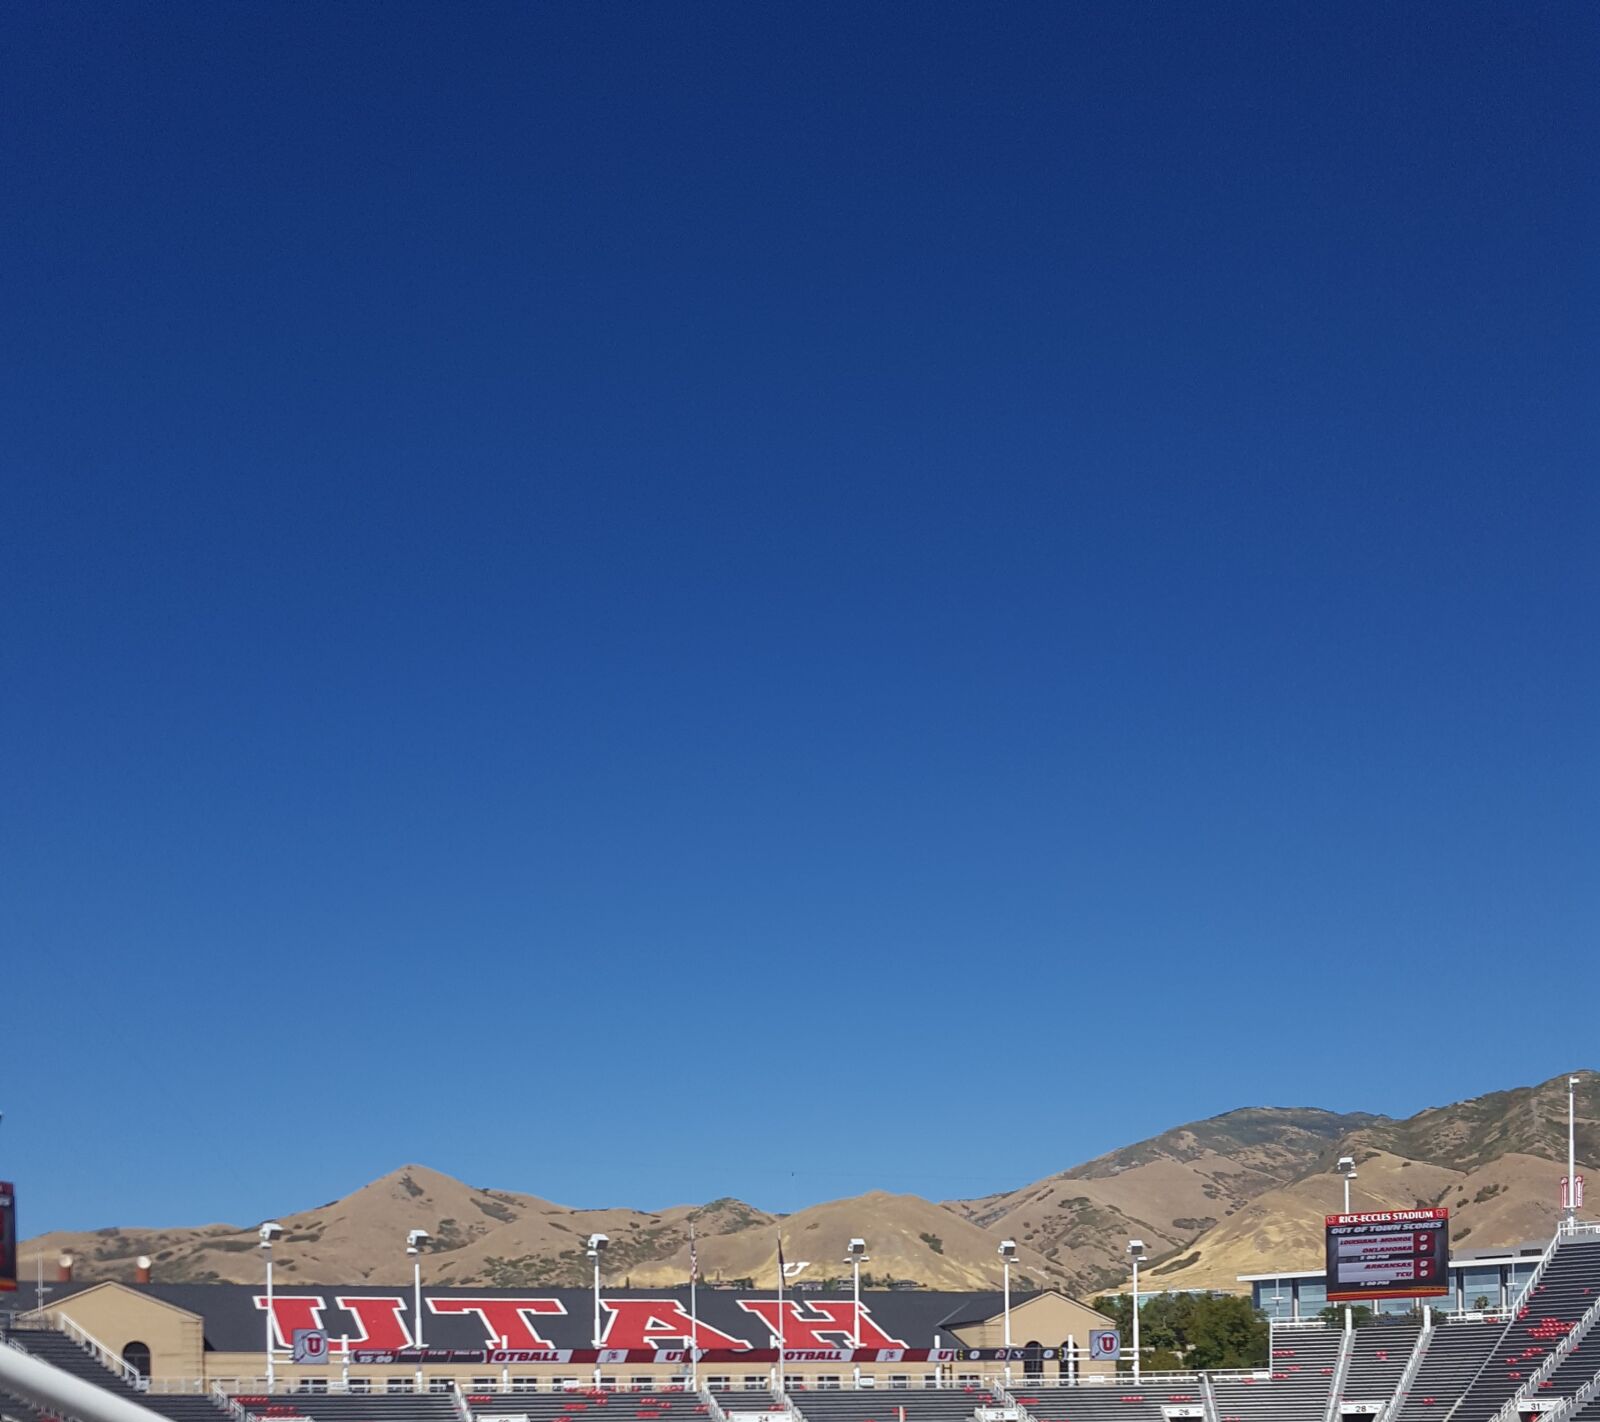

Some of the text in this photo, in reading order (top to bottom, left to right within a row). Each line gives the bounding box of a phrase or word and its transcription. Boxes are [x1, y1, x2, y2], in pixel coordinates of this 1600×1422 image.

[1338, 1213, 1391, 1224] RICE-ECCLES
[1393, 1210, 1433, 1220] STADIUM
[1369, 1224, 1401, 1232] TOWN
[1402, 1221, 1442, 1230] SCORES
[252, 1295, 911, 1352] UTAH
[1355, 1405, 1366, 1413] 28
[1531, 1403, 1540, 1411] 31
